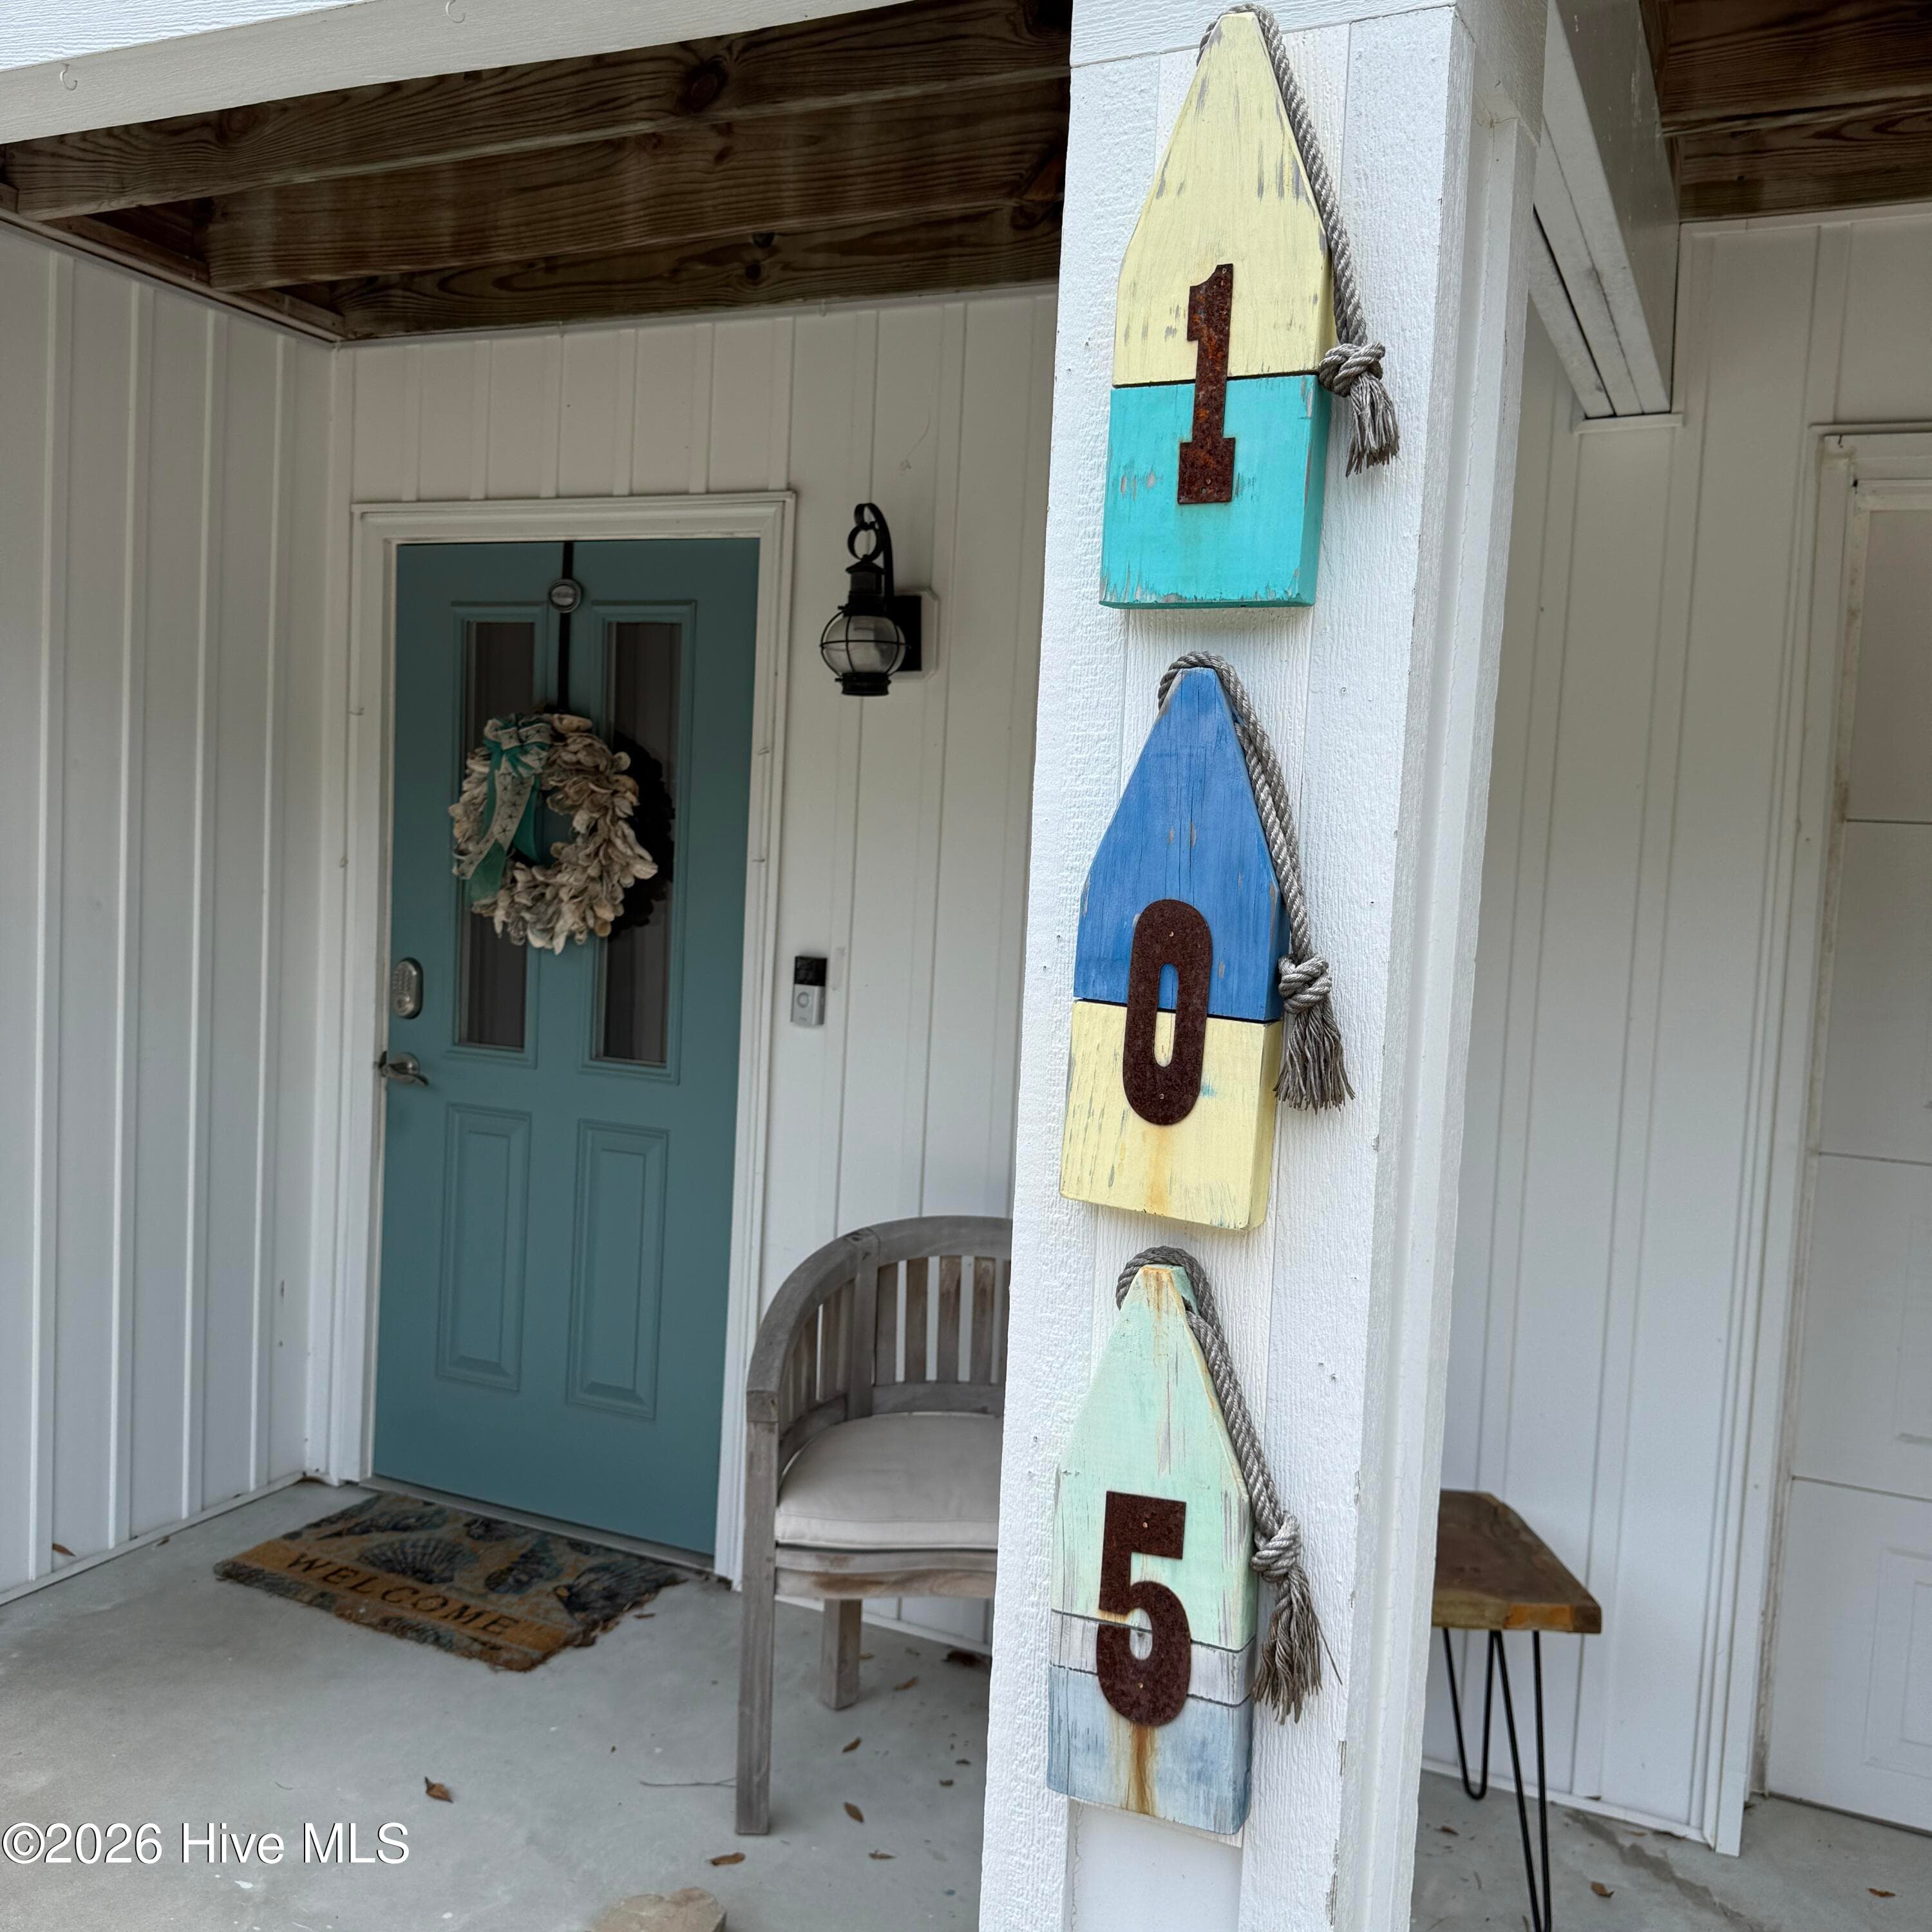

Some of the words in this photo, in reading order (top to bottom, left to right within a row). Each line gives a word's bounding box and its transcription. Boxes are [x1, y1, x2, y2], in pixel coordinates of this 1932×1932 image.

[1179, 263, 1235, 504] 1
[1124, 900, 1211, 1125] 0
[287, 1553, 520, 1634] WELCOME
[1097, 1491, 1191, 1727] 5
